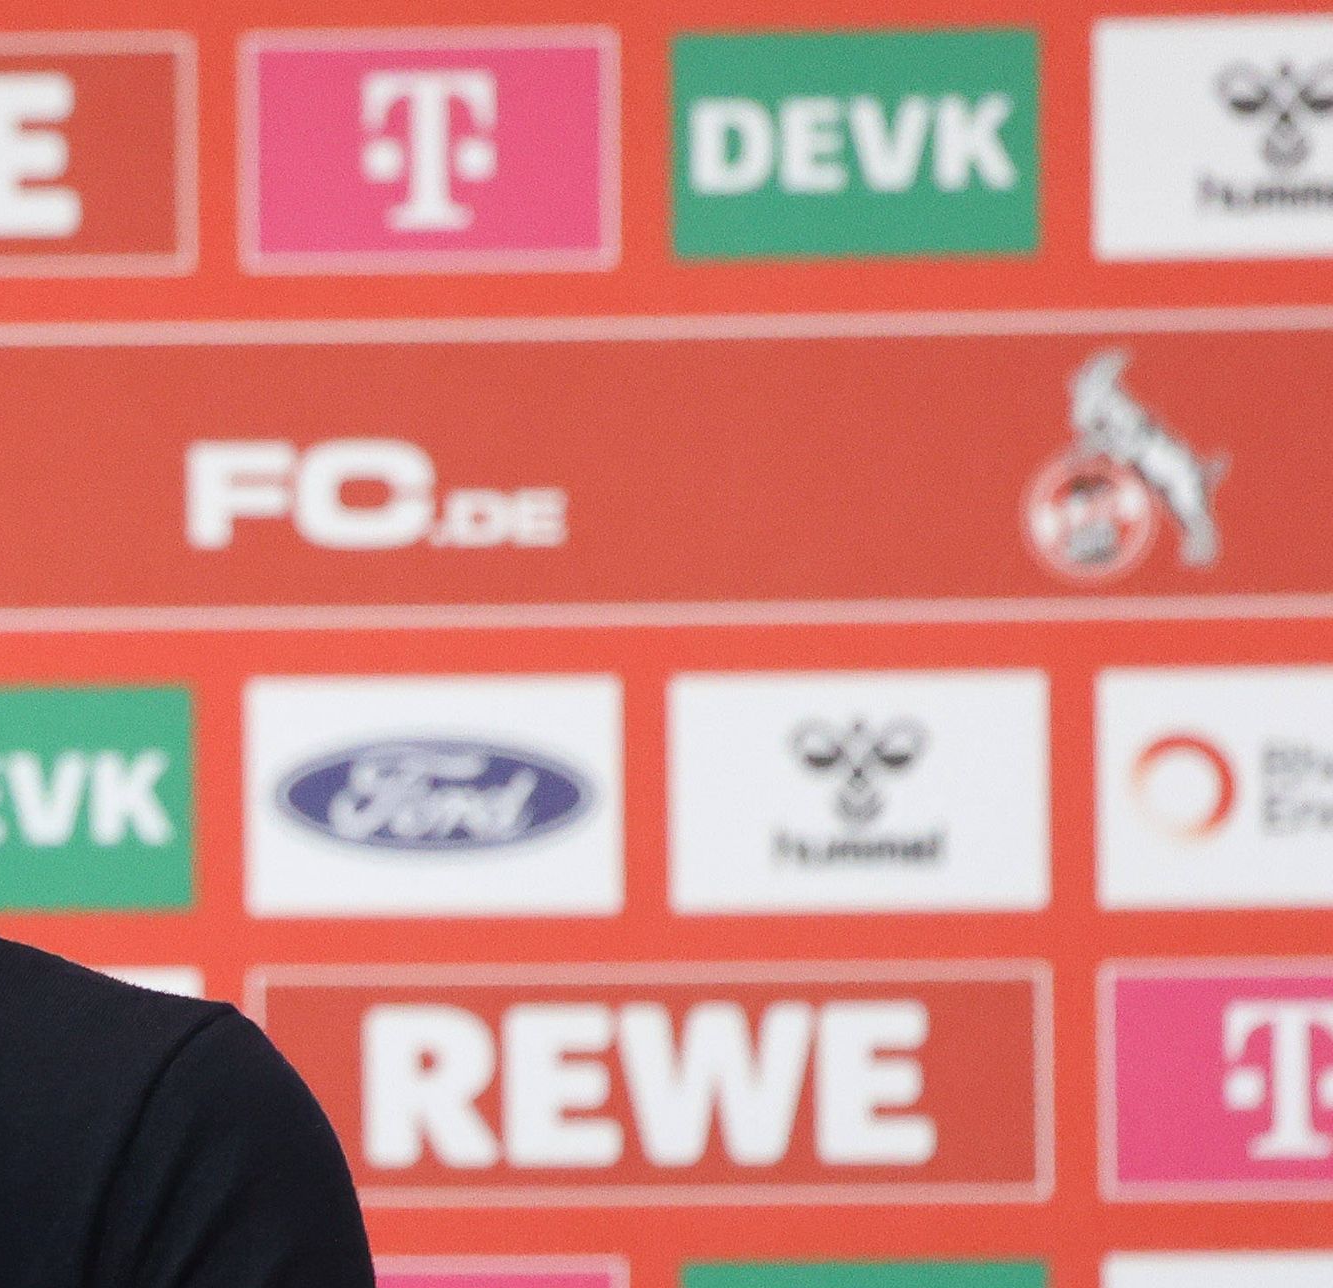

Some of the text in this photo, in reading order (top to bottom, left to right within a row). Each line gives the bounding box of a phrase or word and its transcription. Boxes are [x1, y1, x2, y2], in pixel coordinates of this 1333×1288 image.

[689, 95, 1015, 194] DEVK
[186, 439, 565, 549] FC.DE
[328, 752, 538, 848] Ford
[362, 1001, 935, 1168] REWE
